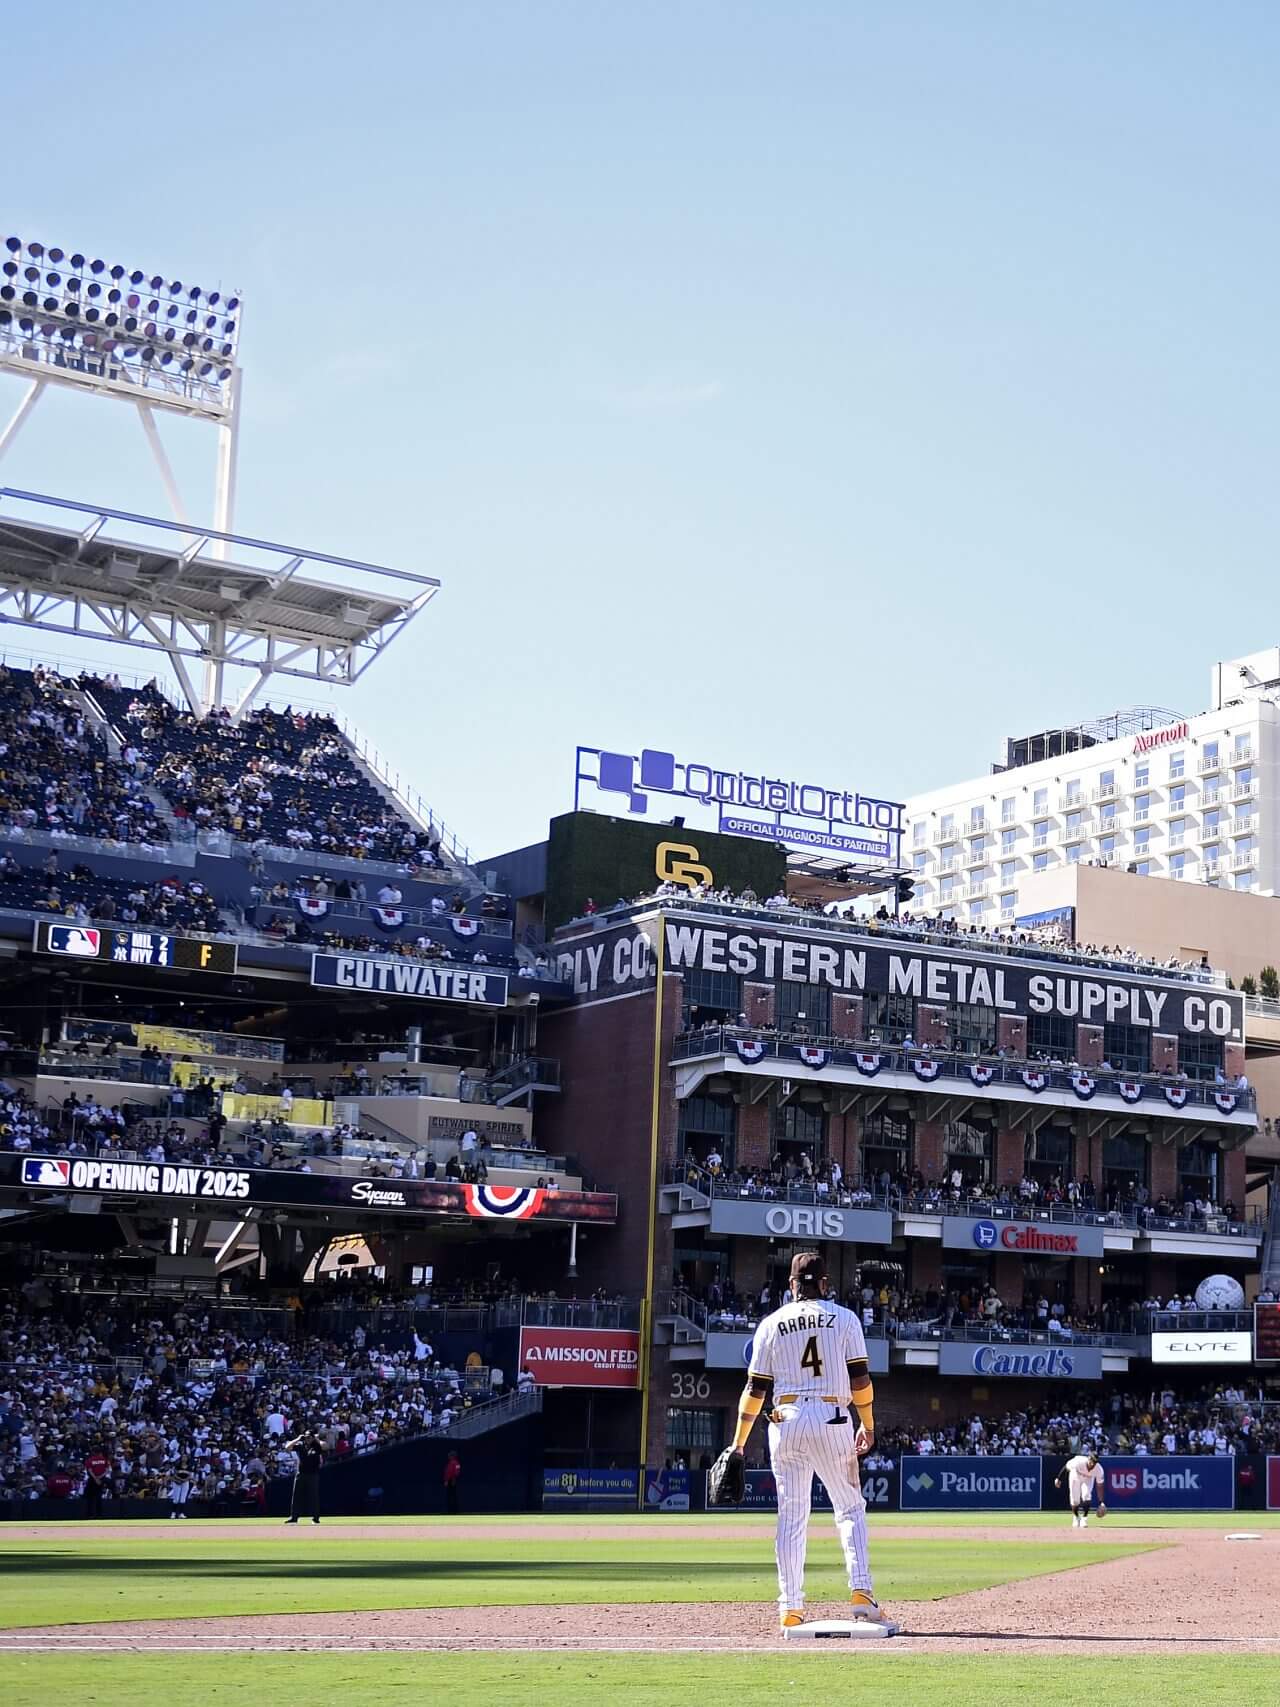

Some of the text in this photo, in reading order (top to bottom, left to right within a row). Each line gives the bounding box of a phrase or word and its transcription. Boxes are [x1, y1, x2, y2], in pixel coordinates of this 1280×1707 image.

[685, 763, 893, 829] QuidelOrtho
[727, 818, 888, 855] OFFICIAL DIAGNOSTICS PARTNER
[132, 932, 169, 949] MIL 2
[130, 947, 168, 966] NYY 4
[200, 944, 212, 967] F
[336, 958, 487, 1001] CUTWATER
[665, 924, 1242, 1038] WESTERN METAL SUPPLY CO.
[72, 1160, 250, 1198] OPENING DAY 2025
[351, 1182, 405, 1205] Sycuan
[765, 1206, 845, 1238] ORIS
[1000, 1225, 1079, 1252] Calimax
[777, 1314, 837, 1337] ARRAEZ
[544, 1346, 638, 1364] MISSION FED
[801, 1335, 823, 1377] 4
[1165, 1342, 1239, 1352] ELYTE
[972, 1345, 1075, 1376] Canel's
[669, 1372, 711, 1399] 336
[544, 1478, 560, 1487] Call
[561, 1472, 578, 1488] 811
[579, 1477, 602, 1488] before
[605, 1479, 620, 1489] you
[939, 1471, 1036, 1493] Palomar
[1111, 1468, 1201, 1490] us bank
